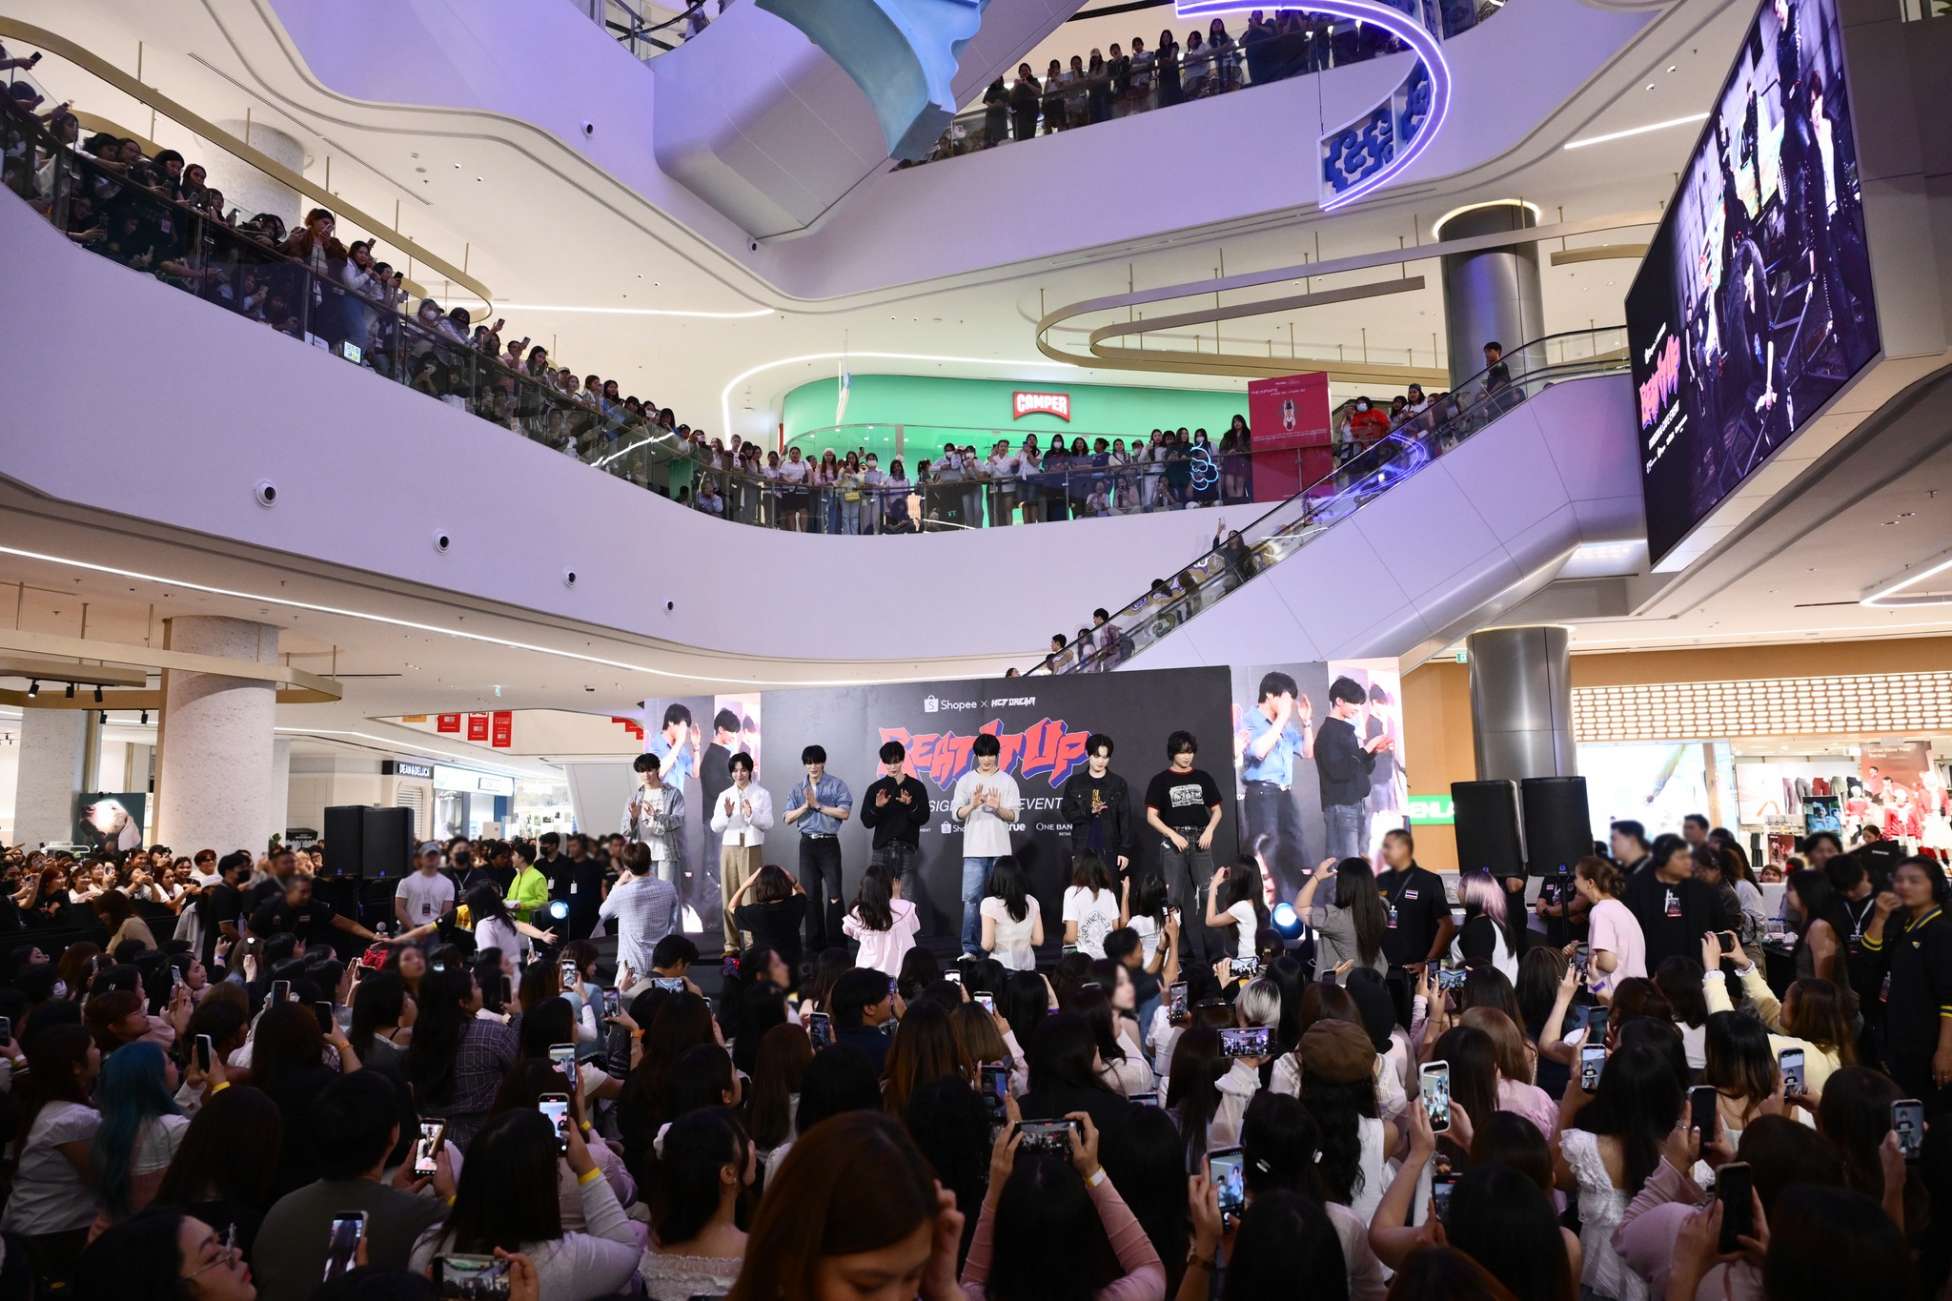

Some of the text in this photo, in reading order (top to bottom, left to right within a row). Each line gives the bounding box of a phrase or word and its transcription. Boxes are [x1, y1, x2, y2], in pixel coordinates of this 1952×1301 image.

[1016, 393, 1068, 415] CAMPER
[940, 699, 978, 712] Shopee
[1021, 716, 1093, 790] UP
[1020, 796, 1064, 810] EVENT
[1008, 822, 1026, 832] rue
[1035, 822, 1073, 831] ONE BAN
